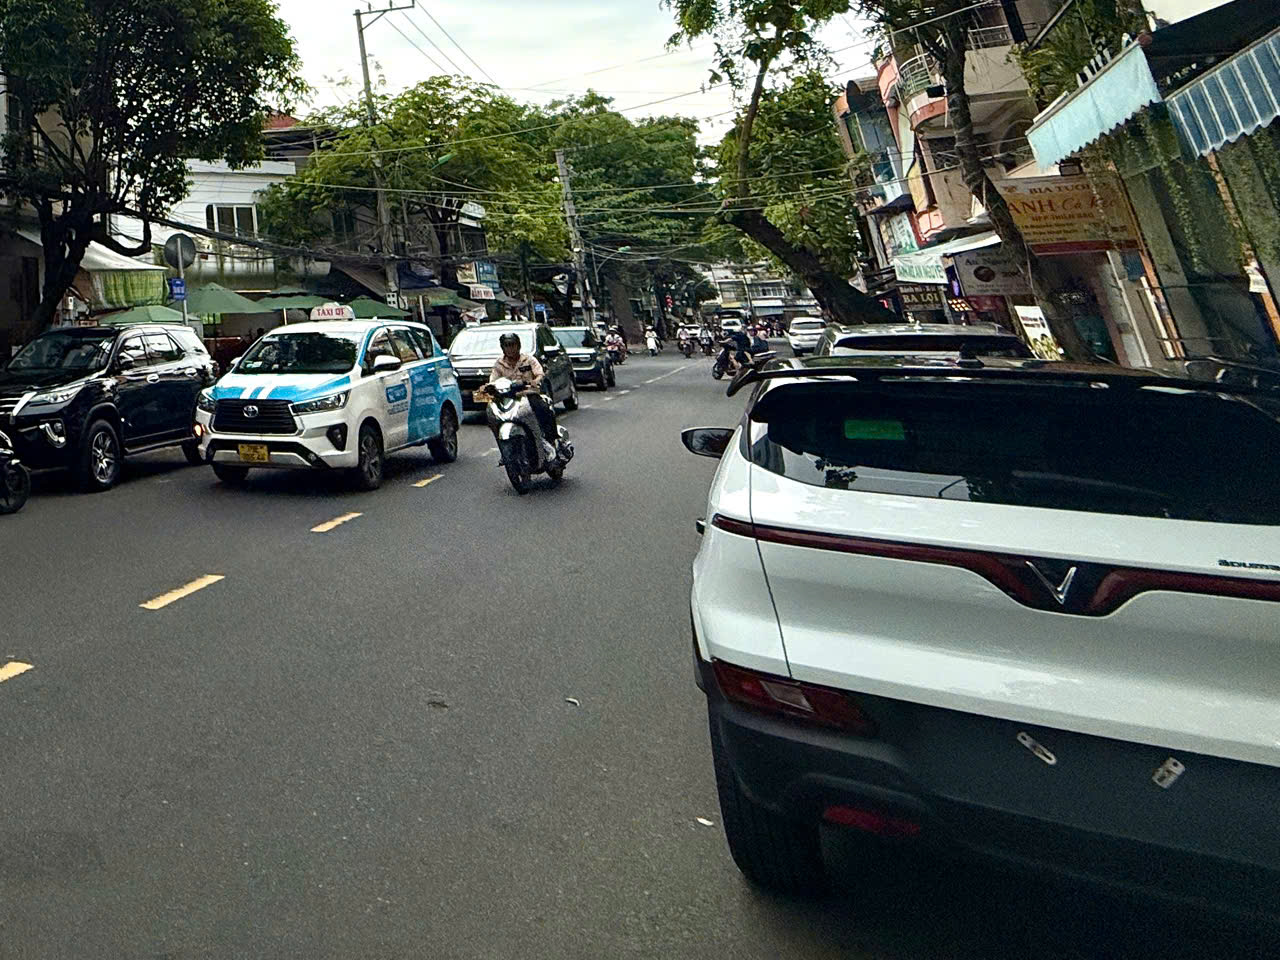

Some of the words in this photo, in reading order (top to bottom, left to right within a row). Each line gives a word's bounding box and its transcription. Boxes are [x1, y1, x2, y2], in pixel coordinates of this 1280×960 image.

[1029, 186, 1051, 194] BIA
[903, 294, 918, 303] BA
[317, 308, 333, 317] TAXI
